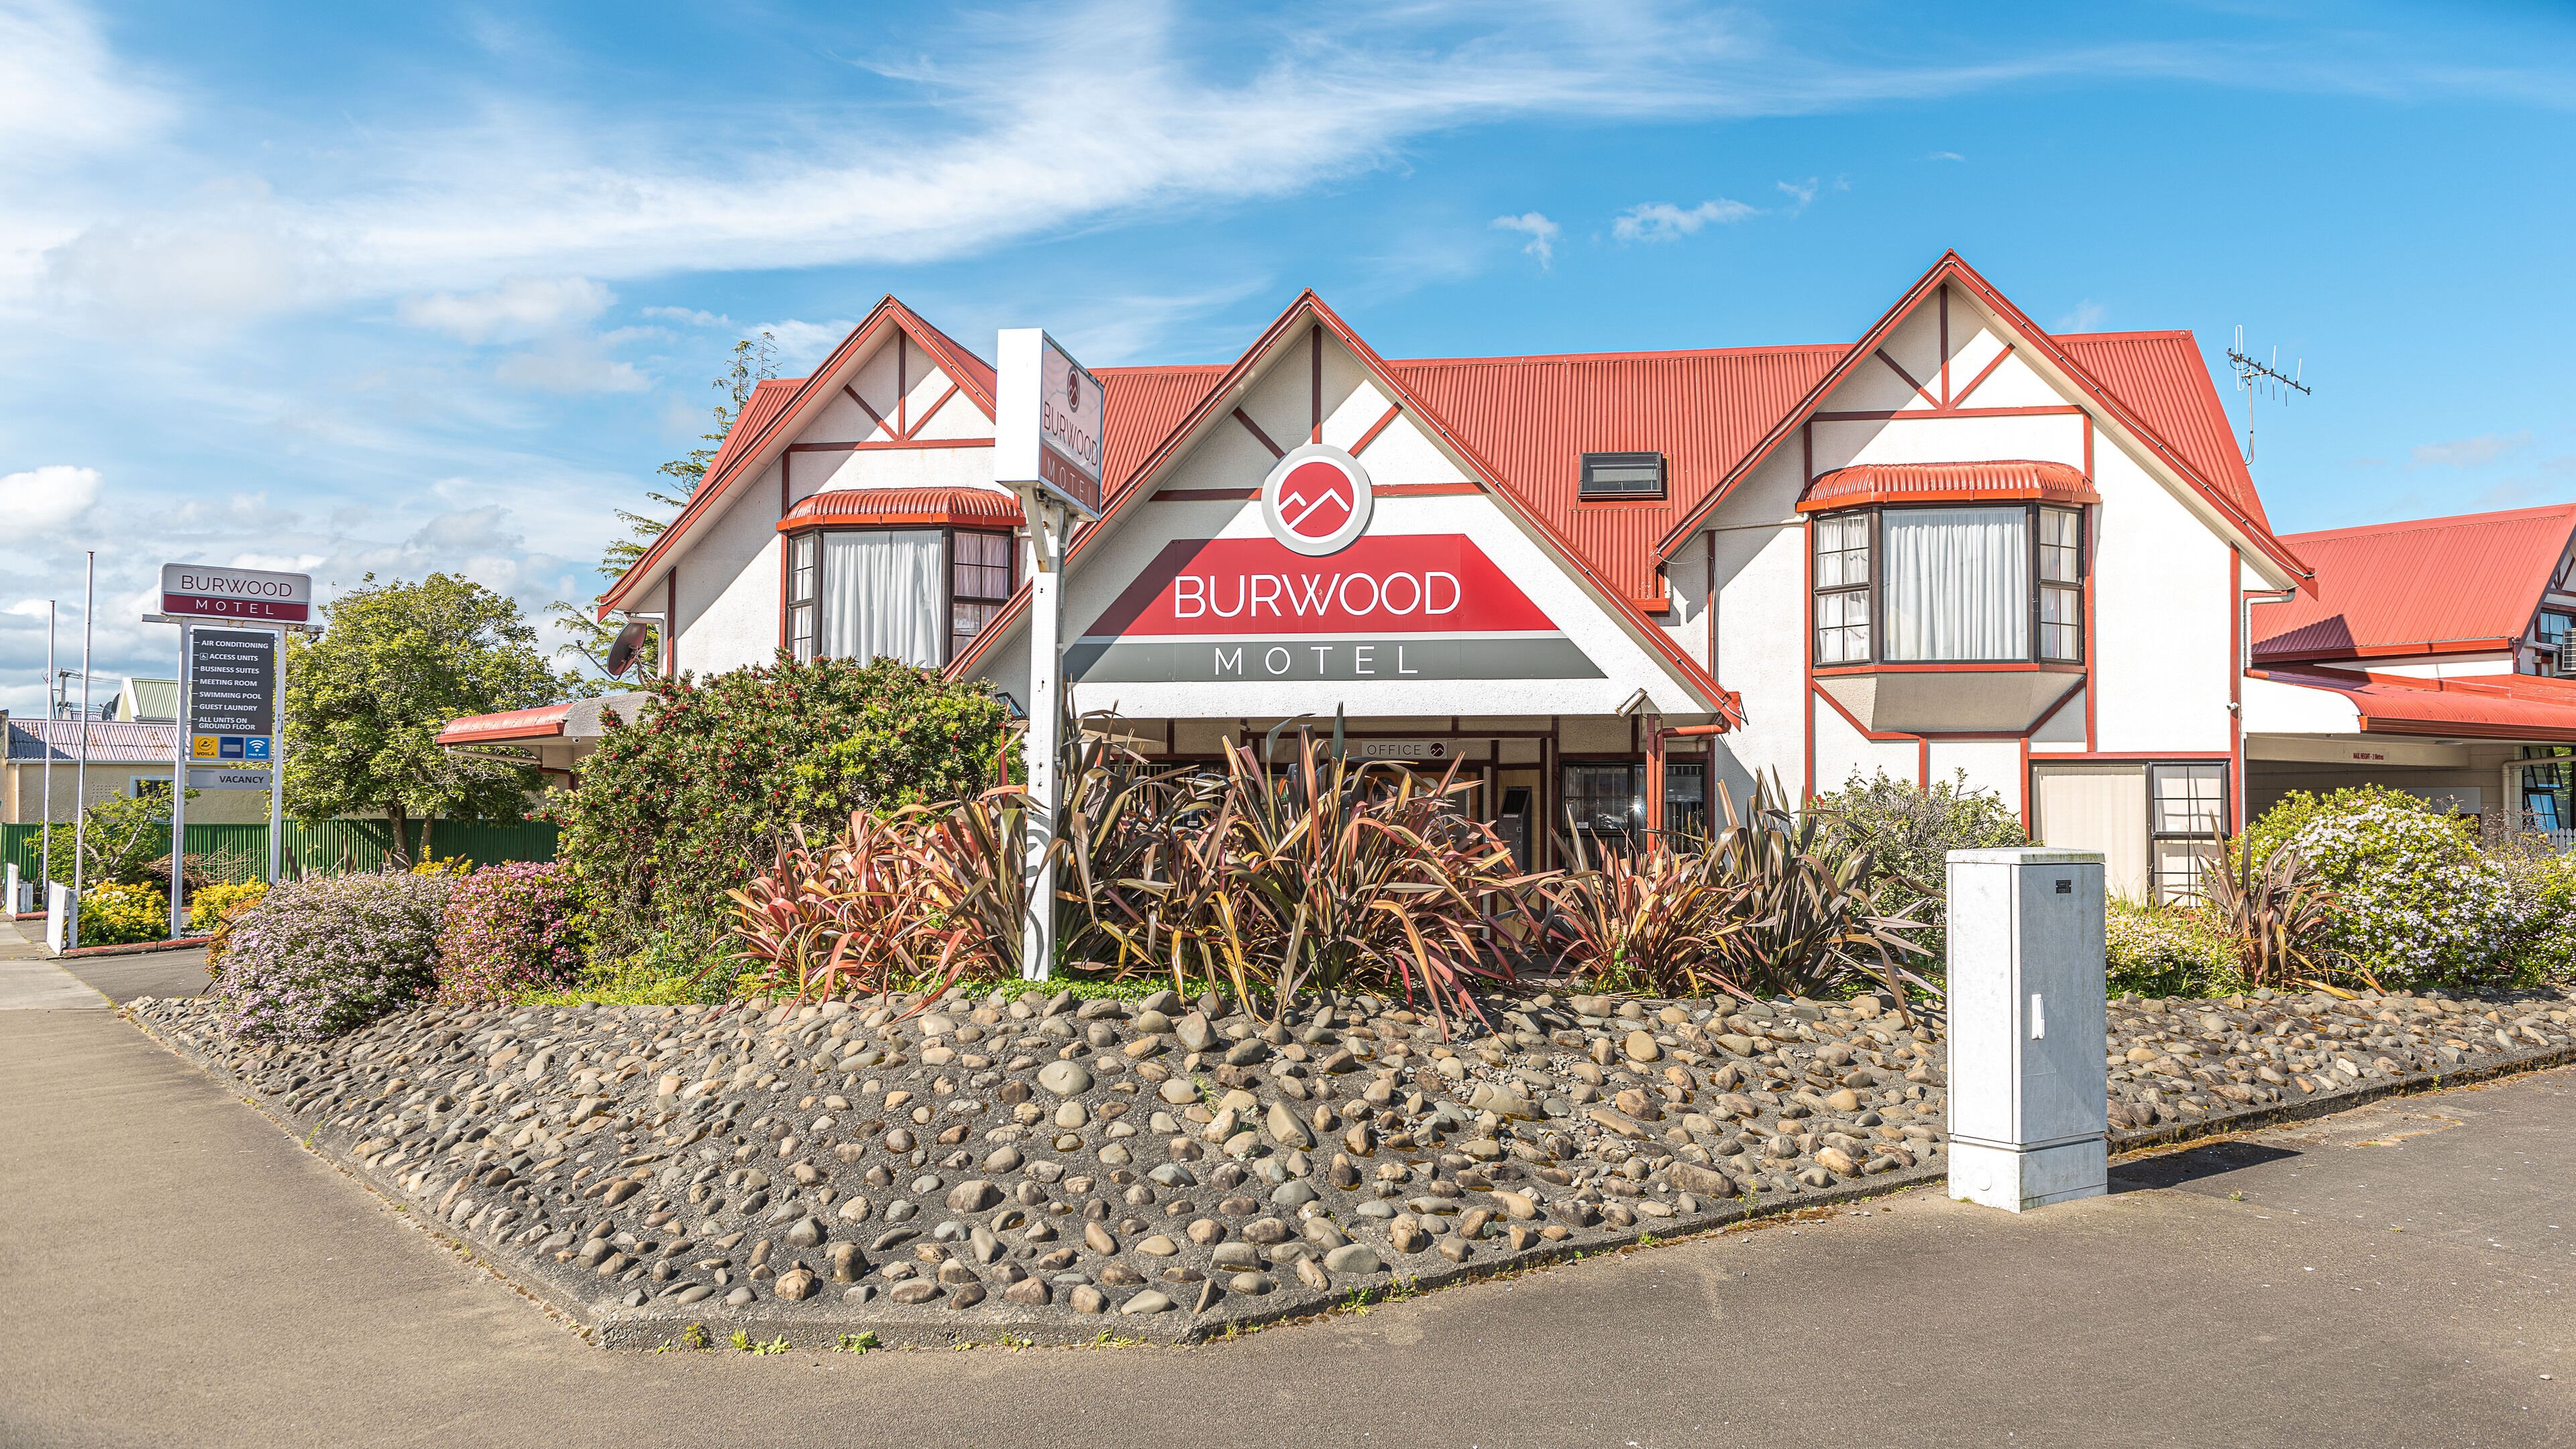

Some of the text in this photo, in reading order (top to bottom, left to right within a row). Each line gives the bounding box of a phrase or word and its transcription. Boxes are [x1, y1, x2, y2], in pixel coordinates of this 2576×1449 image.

[1044, 401, 1098, 466] BURWOOD
[1046, 456, 1093, 508] MOTEL
[182, 575, 292, 597] BURWOOD
[1174, 571, 1462, 619] BURWOOD
[195, 599, 274, 615] MOTEL
[215, 641, 269, 649] CONDITIONING
[1214, 645, 1419, 675] MOTEL
[199, 691, 241, 699] SWIMMING
[1367, 745, 1421, 755] OFFICE
